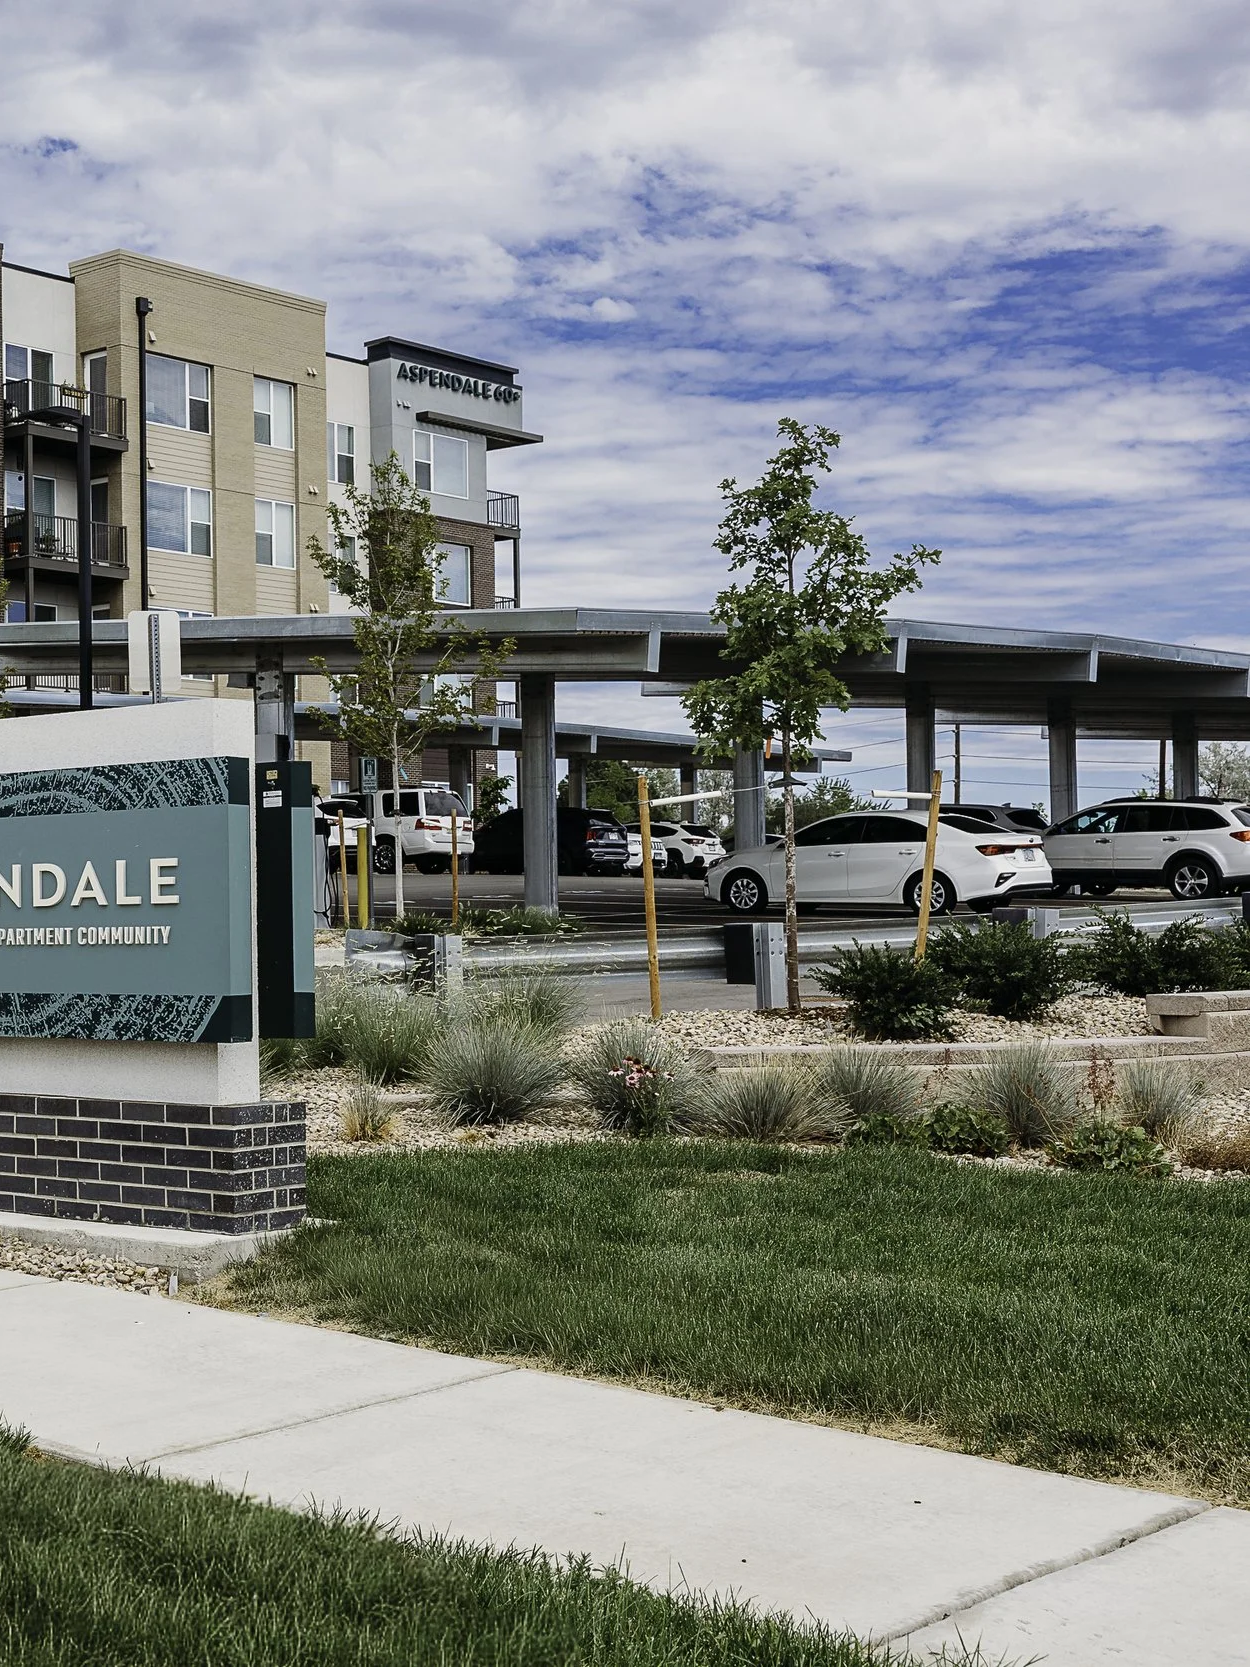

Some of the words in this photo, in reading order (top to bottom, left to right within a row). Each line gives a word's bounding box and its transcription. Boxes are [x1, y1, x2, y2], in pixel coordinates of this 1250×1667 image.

[397, 362, 492, 400] ASPENDALE
[493, 385, 521, 403] 60+
[77, 925, 171, 945] COMMUNITY
